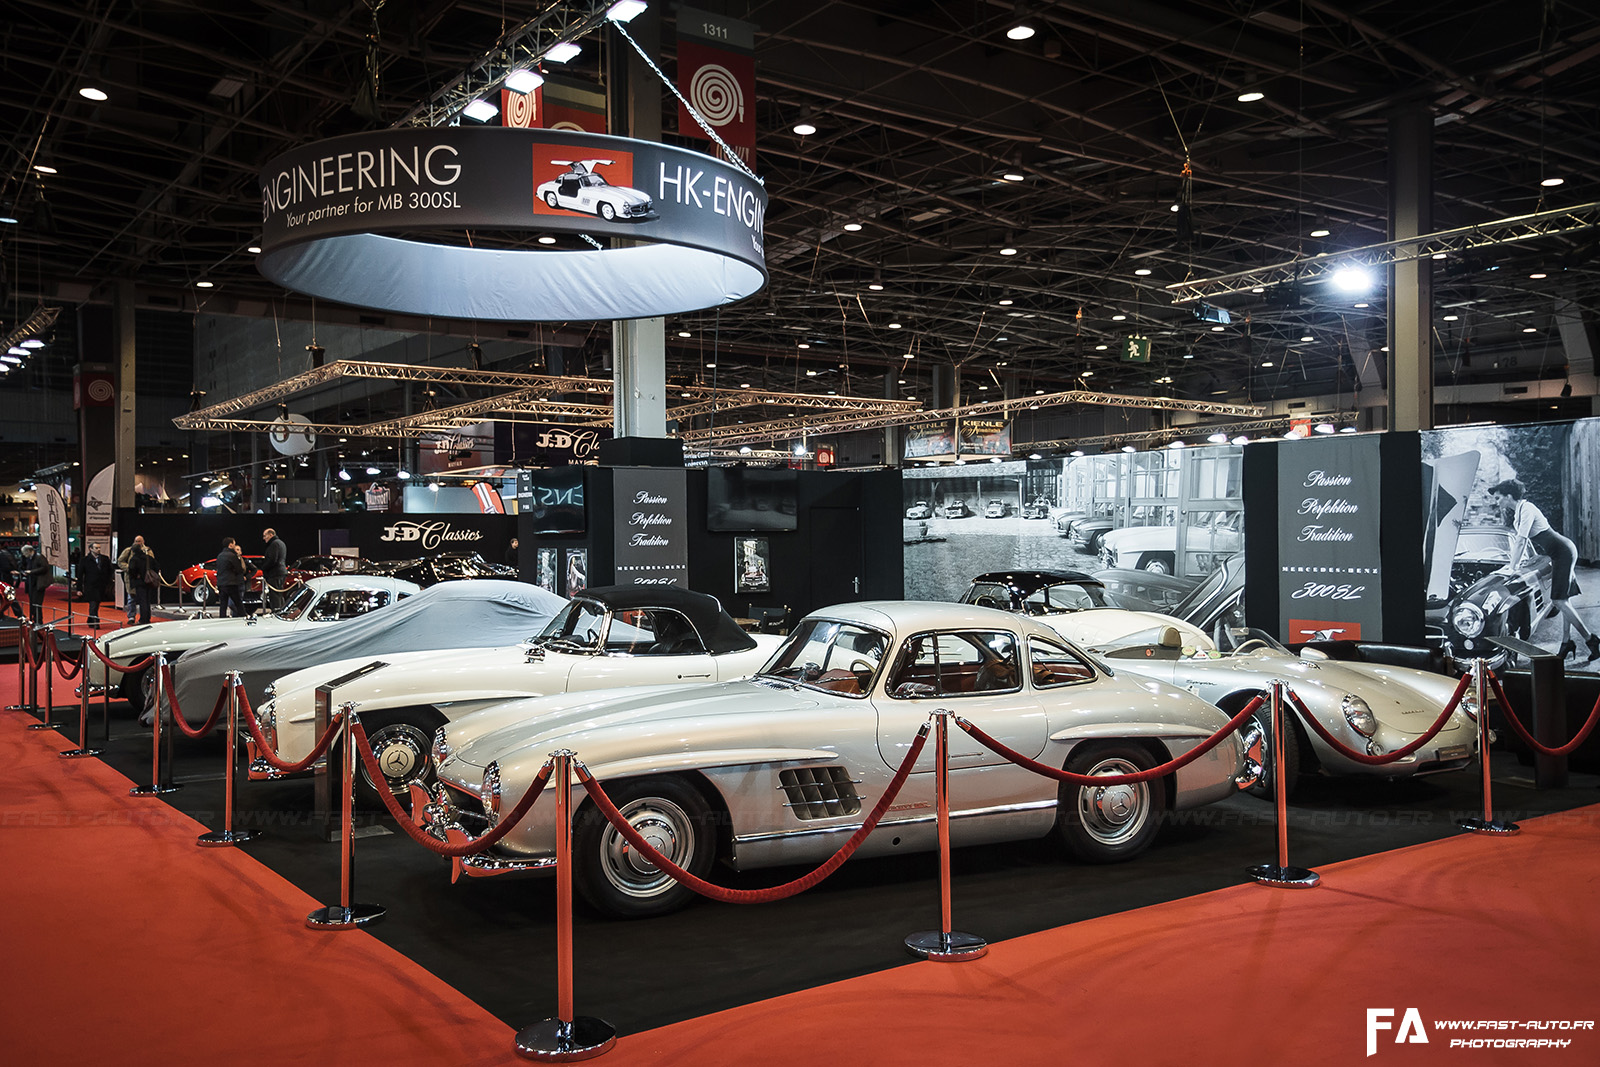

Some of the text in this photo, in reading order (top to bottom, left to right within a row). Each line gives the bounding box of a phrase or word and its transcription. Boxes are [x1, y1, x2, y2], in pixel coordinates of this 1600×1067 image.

[702, 23, 727, 39] 1311
[286, 192, 461, 228] Your partner for MB 300SL
[909, 421, 948, 431] KIENLE
[963, 420, 1004, 428] KIENLE
[536, 433, 572, 448] J.D
[1303, 470, 1352, 488] Passion
[632, 490, 668, 504] Passion
[1297, 497, 1359, 520] Perfektion
[628, 512, 673, 530] Perfektion
[380, 520, 484, 550] J.D Classics
[628, 533, 669, 547] Tradition
[1297, 525, 1354, 542] Tradition
[1282, 566, 1378, 574] MERCEDES-BENZ
